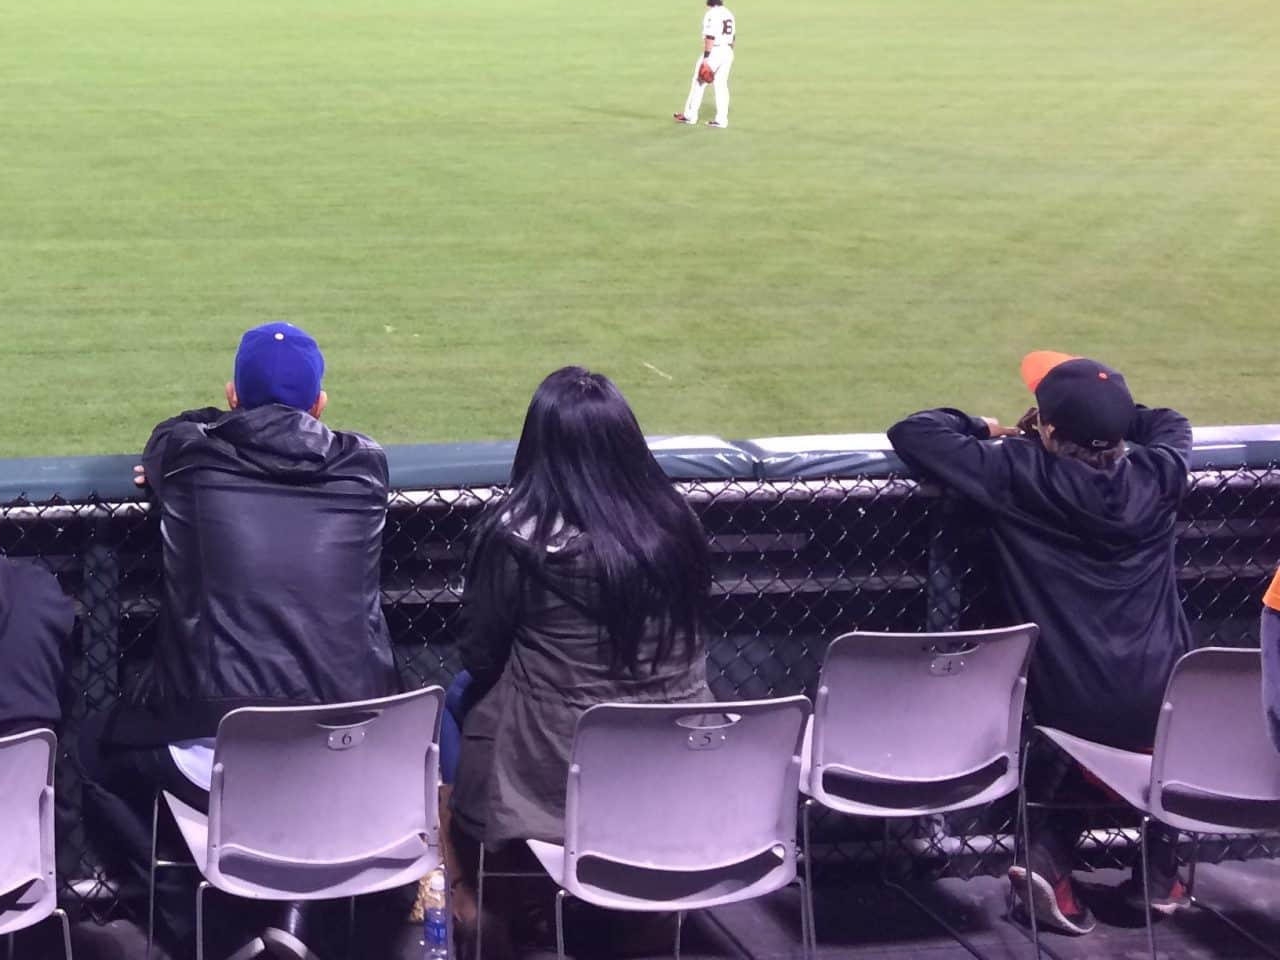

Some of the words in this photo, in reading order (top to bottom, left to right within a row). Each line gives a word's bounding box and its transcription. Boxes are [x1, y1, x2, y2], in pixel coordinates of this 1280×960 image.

[722, 19, 733, 35] 16
[342, 732, 352, 745] 6
[700, 732, 712, 746] 5
